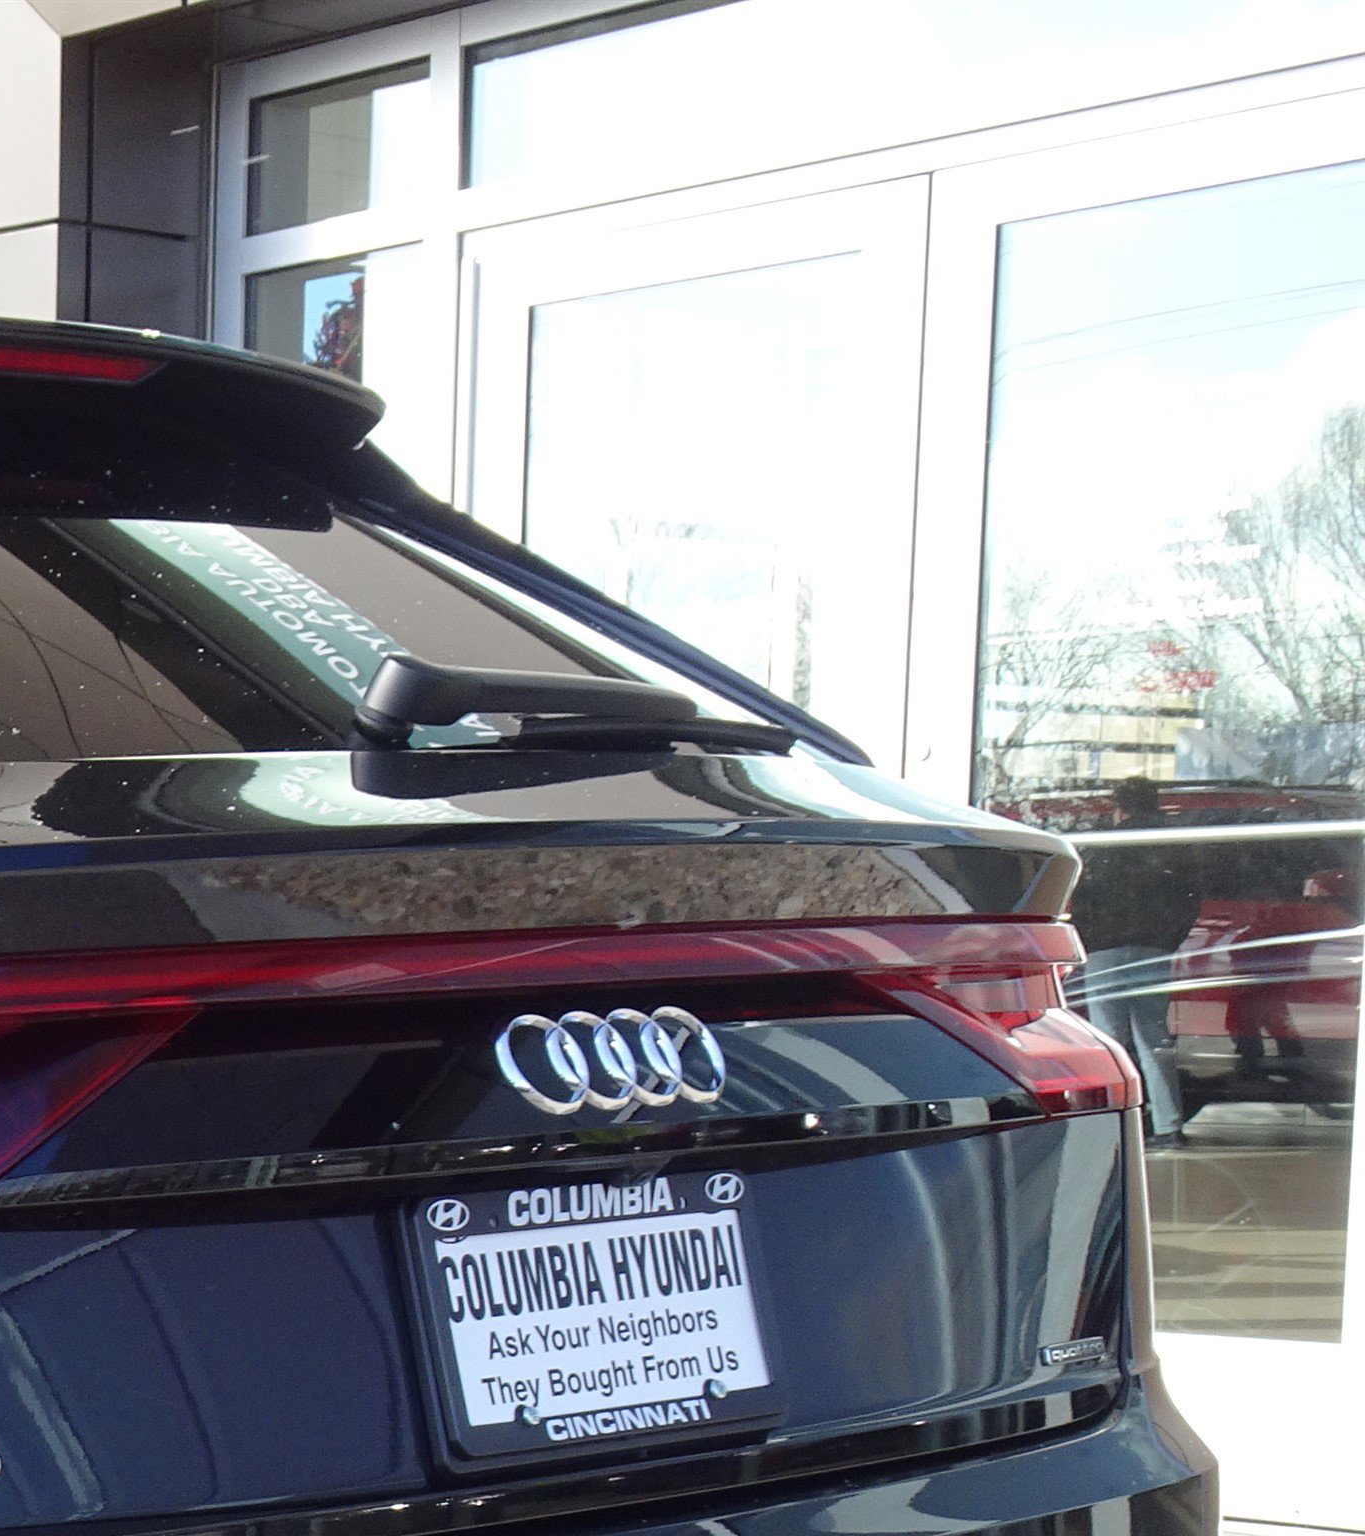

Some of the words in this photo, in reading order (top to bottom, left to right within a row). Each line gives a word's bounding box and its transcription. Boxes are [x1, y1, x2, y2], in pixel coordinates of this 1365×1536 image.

[507, 1177, 674, 1227] COLUMBIA
[438, 1240, 607, 1323] COLUMBIA
[608, 1224, 742, 1302] HYUNDAI
[488, 1330, 533, 1360] Ask
[535, 1322, 590, 1354] Your
[598, 1306, 718, 1347] Neighbors
[1051, 1341, 1106, 1362] quattro
[481, 1376, 540, 1408] They
[548, 1358, 636, 1400] Bought
[643, 1353, 701, 1386] From
[707, 1346, 739, 1374] Us
[545, 1399, 712, 1442] CINCINNATI
